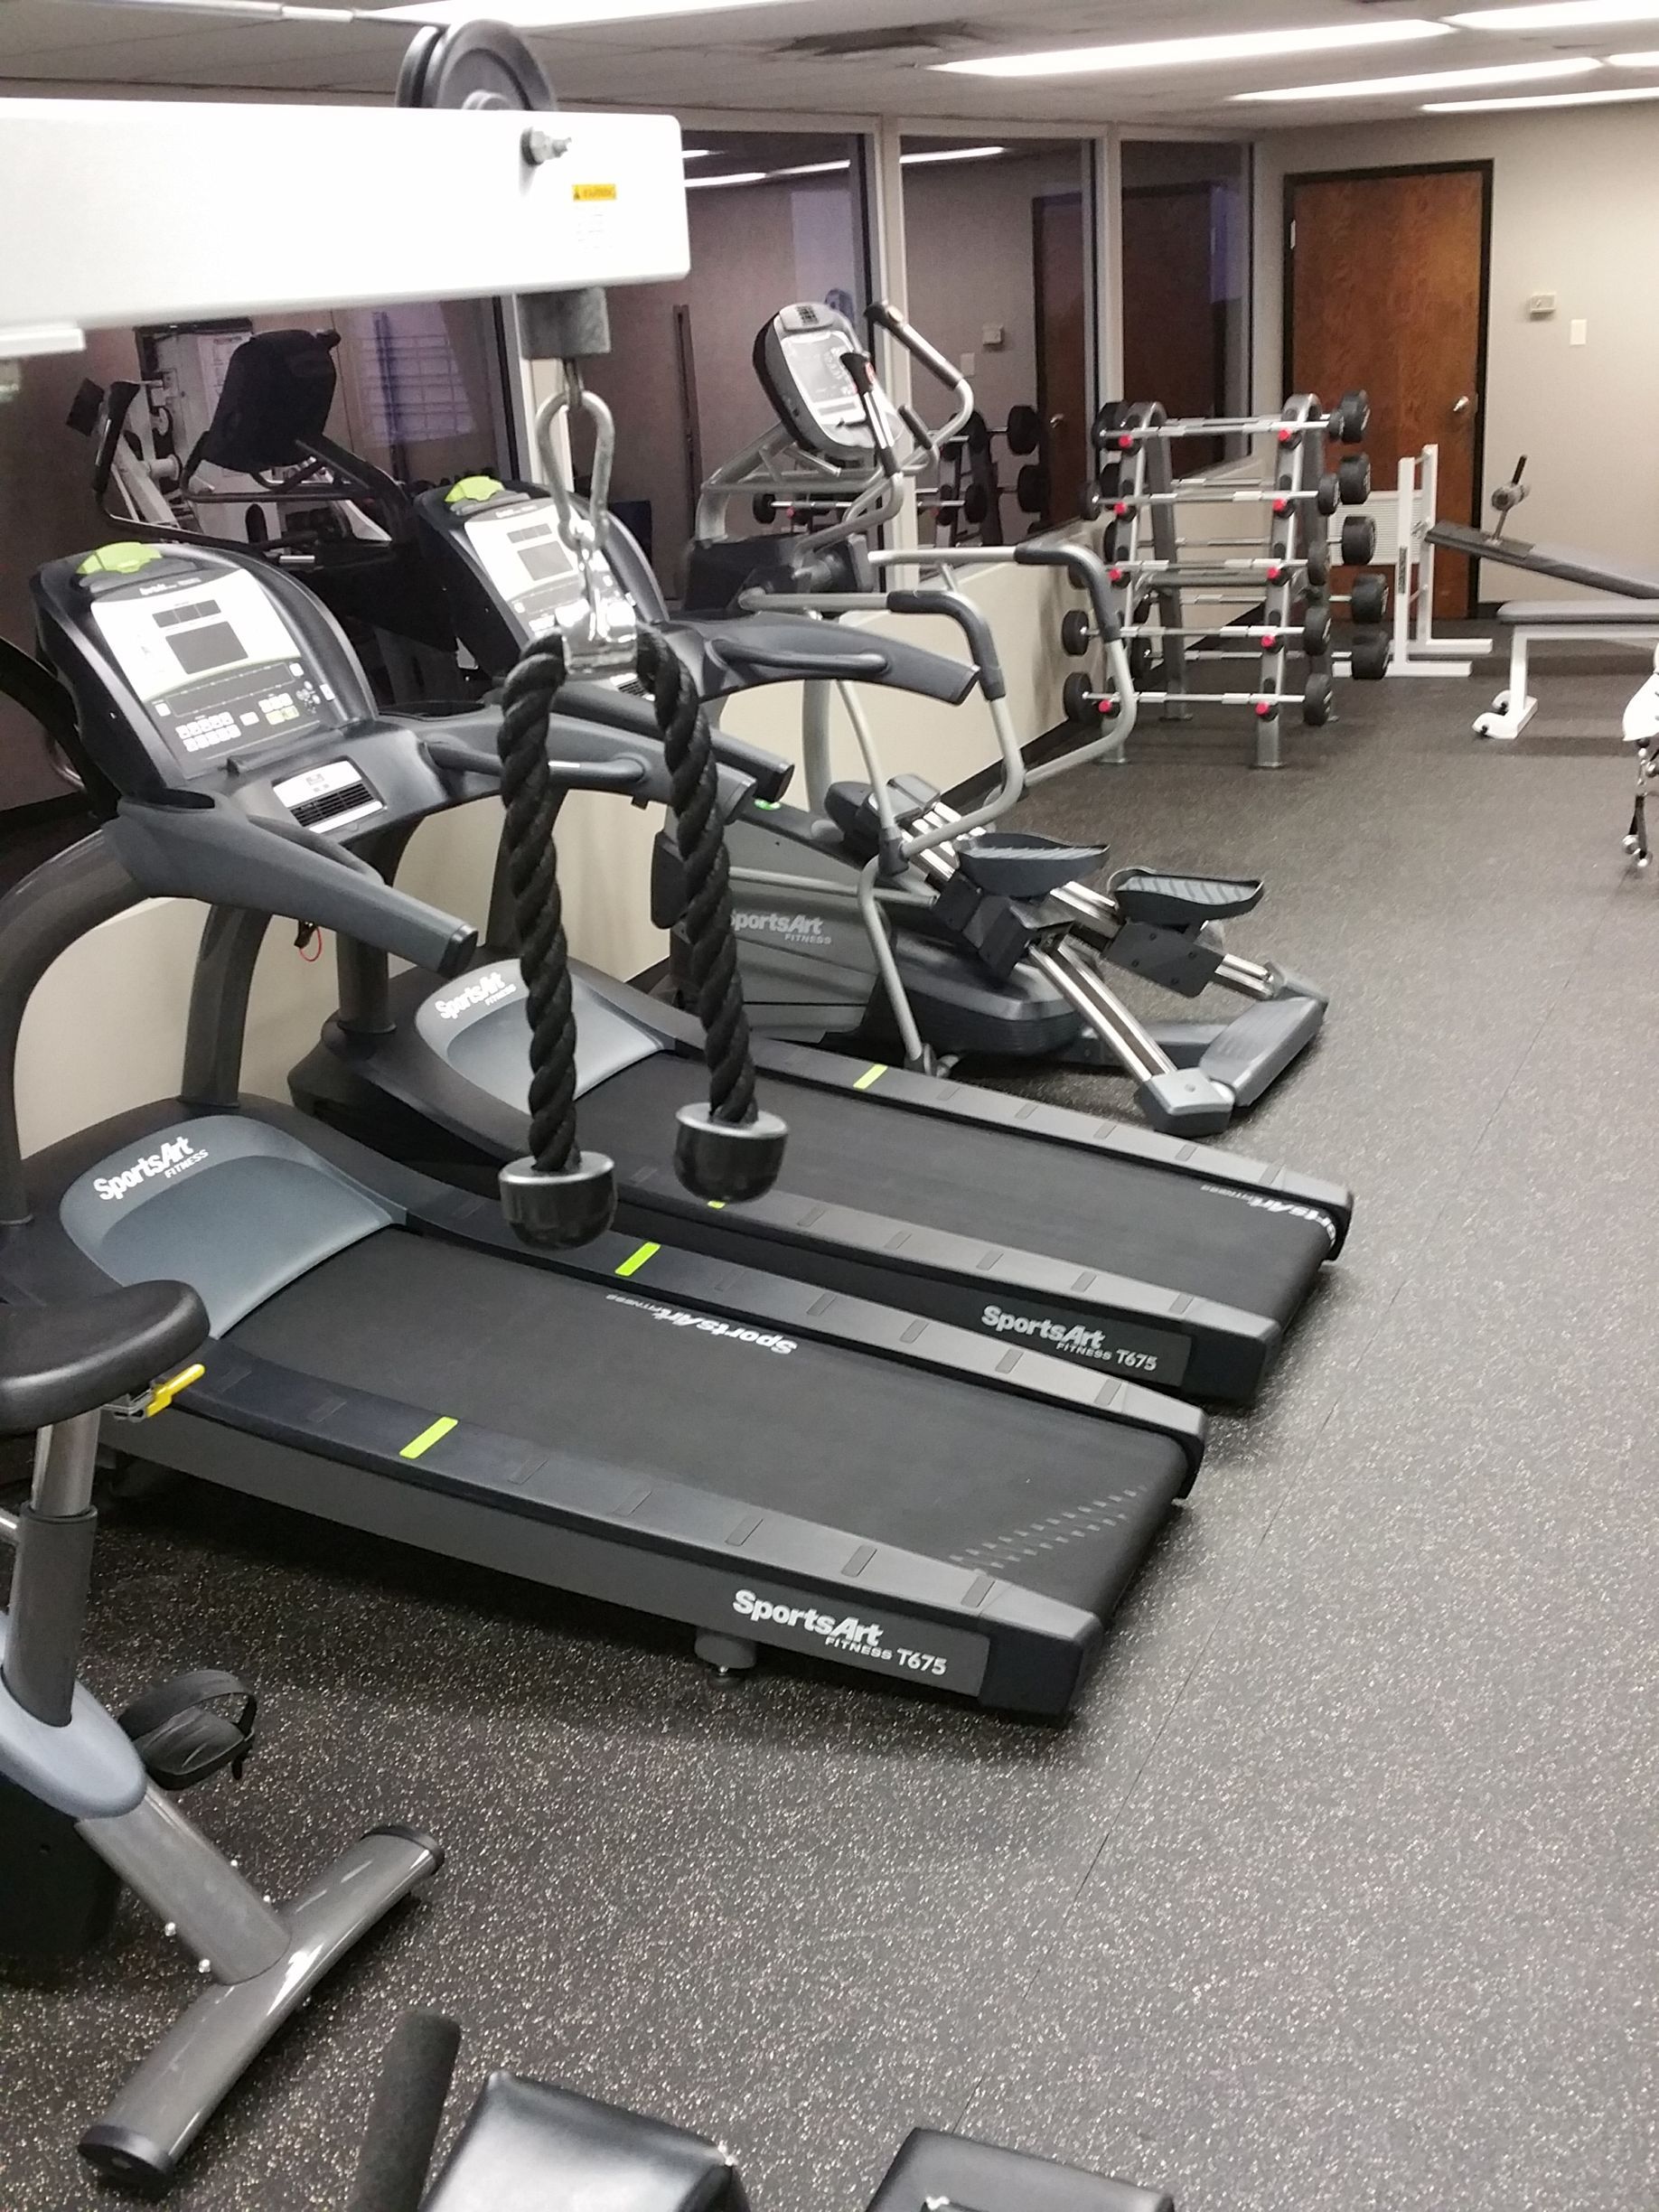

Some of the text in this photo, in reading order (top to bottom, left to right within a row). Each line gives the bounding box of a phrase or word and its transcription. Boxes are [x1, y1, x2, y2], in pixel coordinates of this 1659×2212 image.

[784, 933, 832, 944] FITNESS
[436, 971, 506, 1019] SportsArt
[93, 1136, 193, 1200] SportsArt
[164, 1148, 210, 1178] FITNESS
[605, 1293, 799, 1355] SportsArt FITNESS
[981, 1304, 1106, 1349] SportsArt
[1055, 1342, 1158, 1372] FITNESS T675
[732, 1589, 884, 1646] SportsArt
[825, 1636, 948, 1676] FITNESS T675
